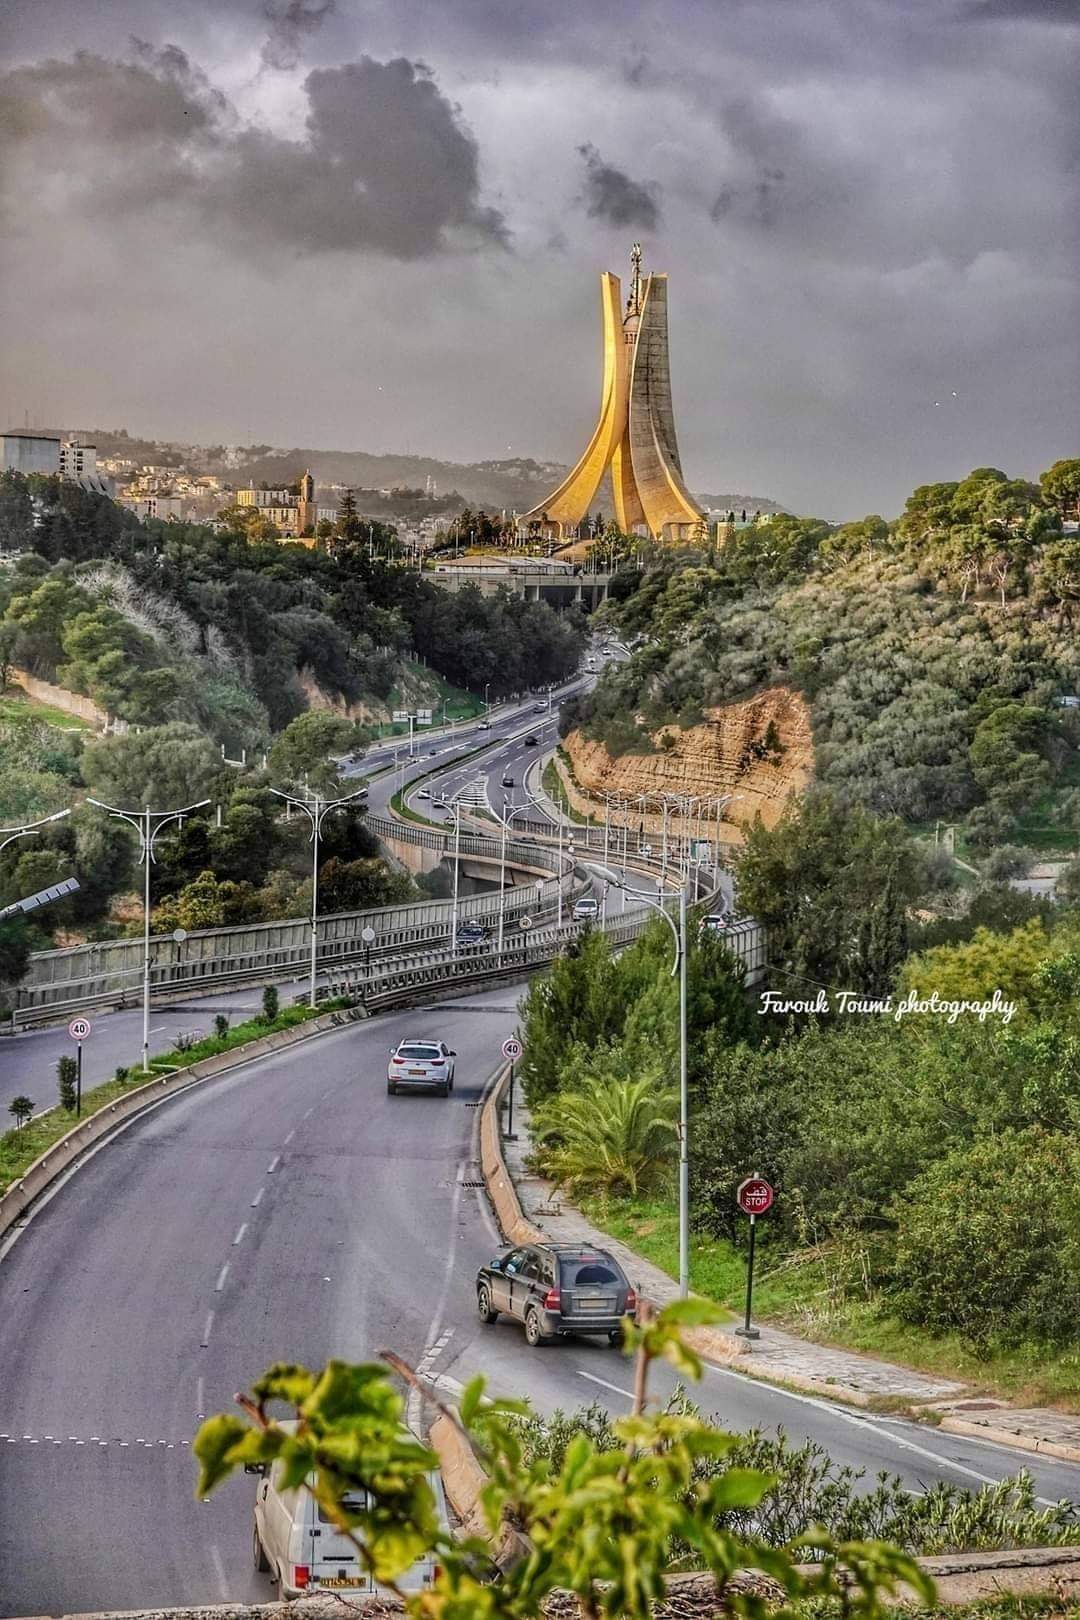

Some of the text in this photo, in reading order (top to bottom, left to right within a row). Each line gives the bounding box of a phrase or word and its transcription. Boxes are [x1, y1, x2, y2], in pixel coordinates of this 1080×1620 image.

[73, 1024, 85, 1033] 40
[506, 1044, 518, 1054] 40
[745, 1197, 767, 1206] STOP
